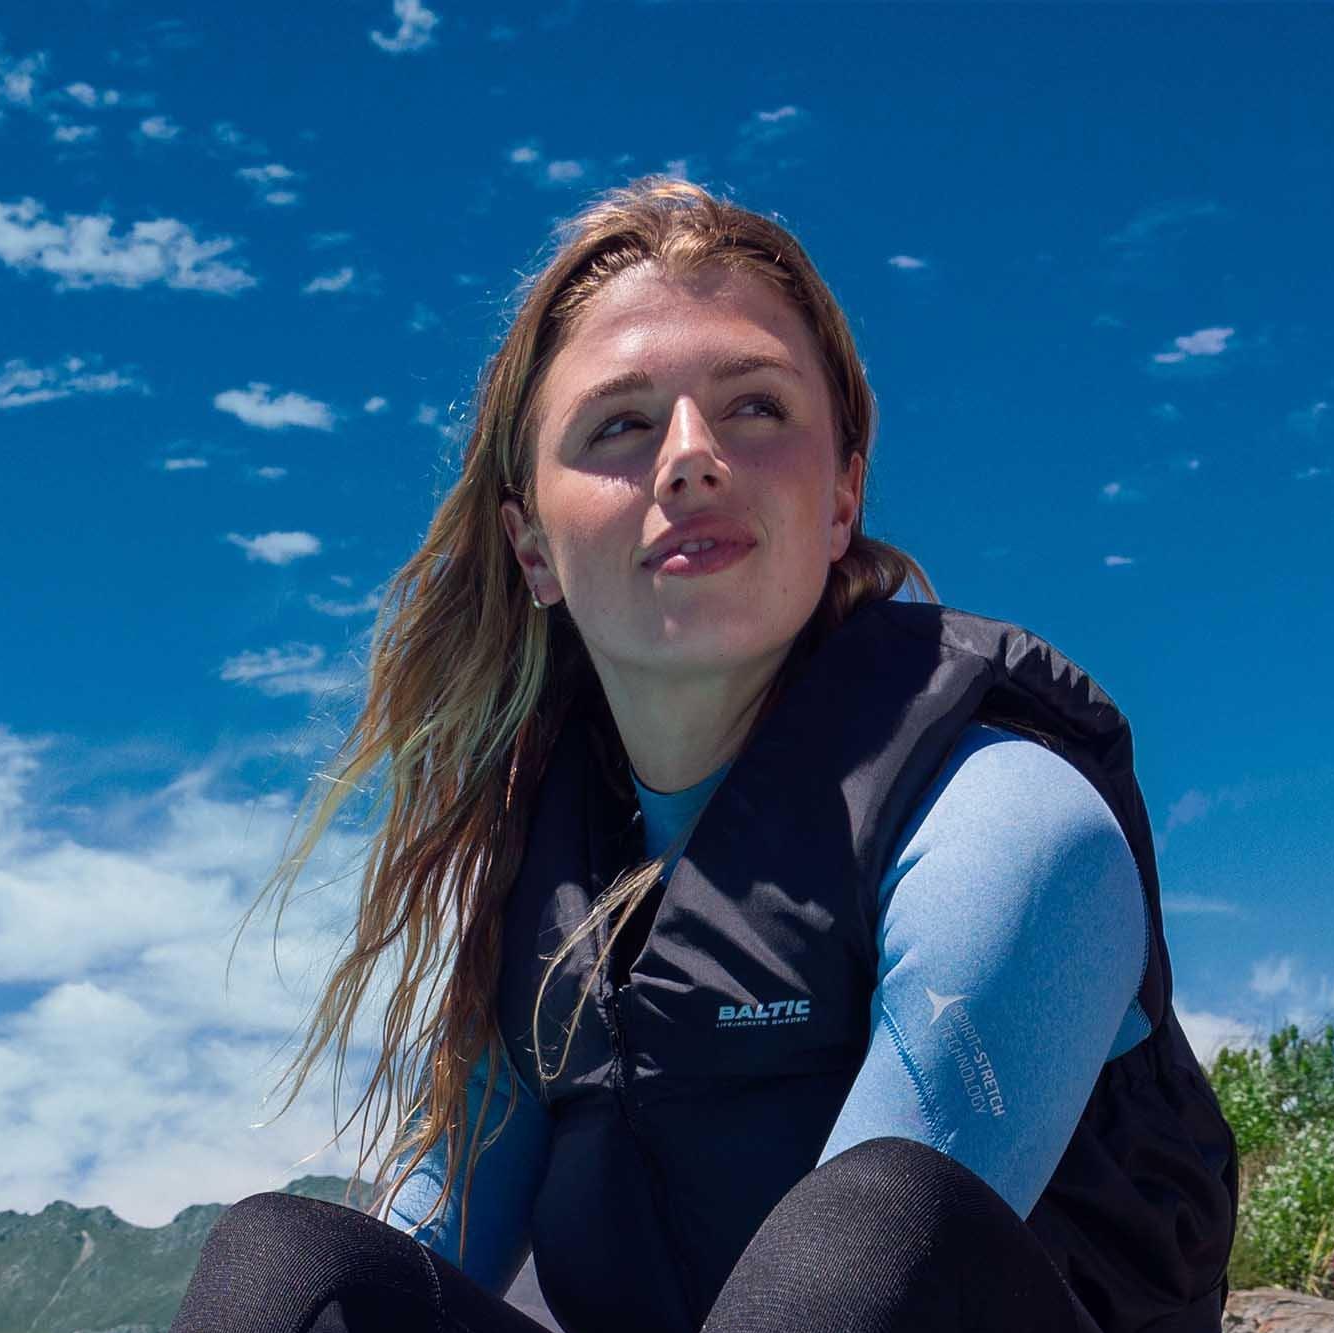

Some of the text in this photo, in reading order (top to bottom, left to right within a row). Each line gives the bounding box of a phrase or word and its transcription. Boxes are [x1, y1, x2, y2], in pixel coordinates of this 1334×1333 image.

[718, 1000, 810, 1020] BALTIC
[940, 1021, 986, 1113] TECHNOLOGY
[950, 1003, 1005, 1117] SPIRIT-STRETCH
